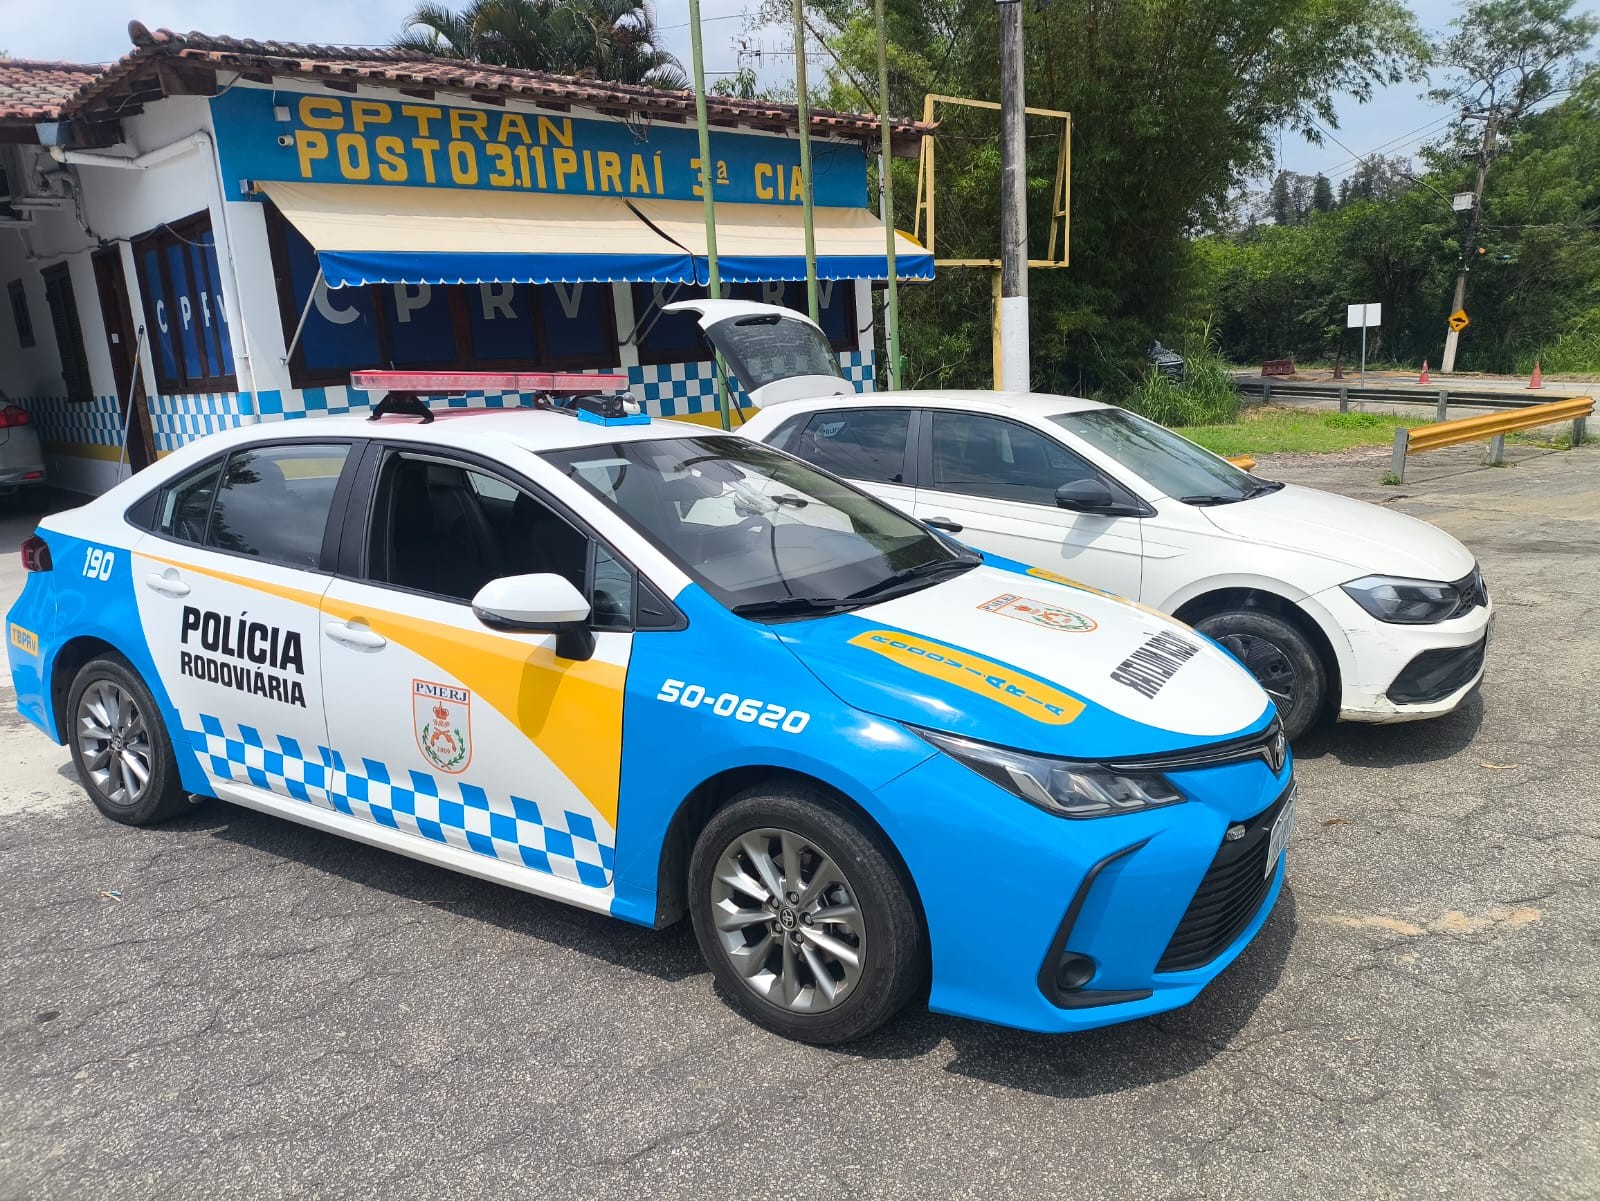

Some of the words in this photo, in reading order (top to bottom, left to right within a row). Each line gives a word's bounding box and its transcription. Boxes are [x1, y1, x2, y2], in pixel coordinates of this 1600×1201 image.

[298, 96, 573, 147] CPTRAN
[295, 130, 479, 185] POSTO
[553, 148, 665, 195] PIRAÍ
[82, 546, 115, 582] 190
[181, 605, 305, 675] POLÍCIA
[180, 650, 307, 708] RODOVIÁRIA
[415, 682, 467, 702] PMERJ
[656, 678, 811, 734] 50-0620
